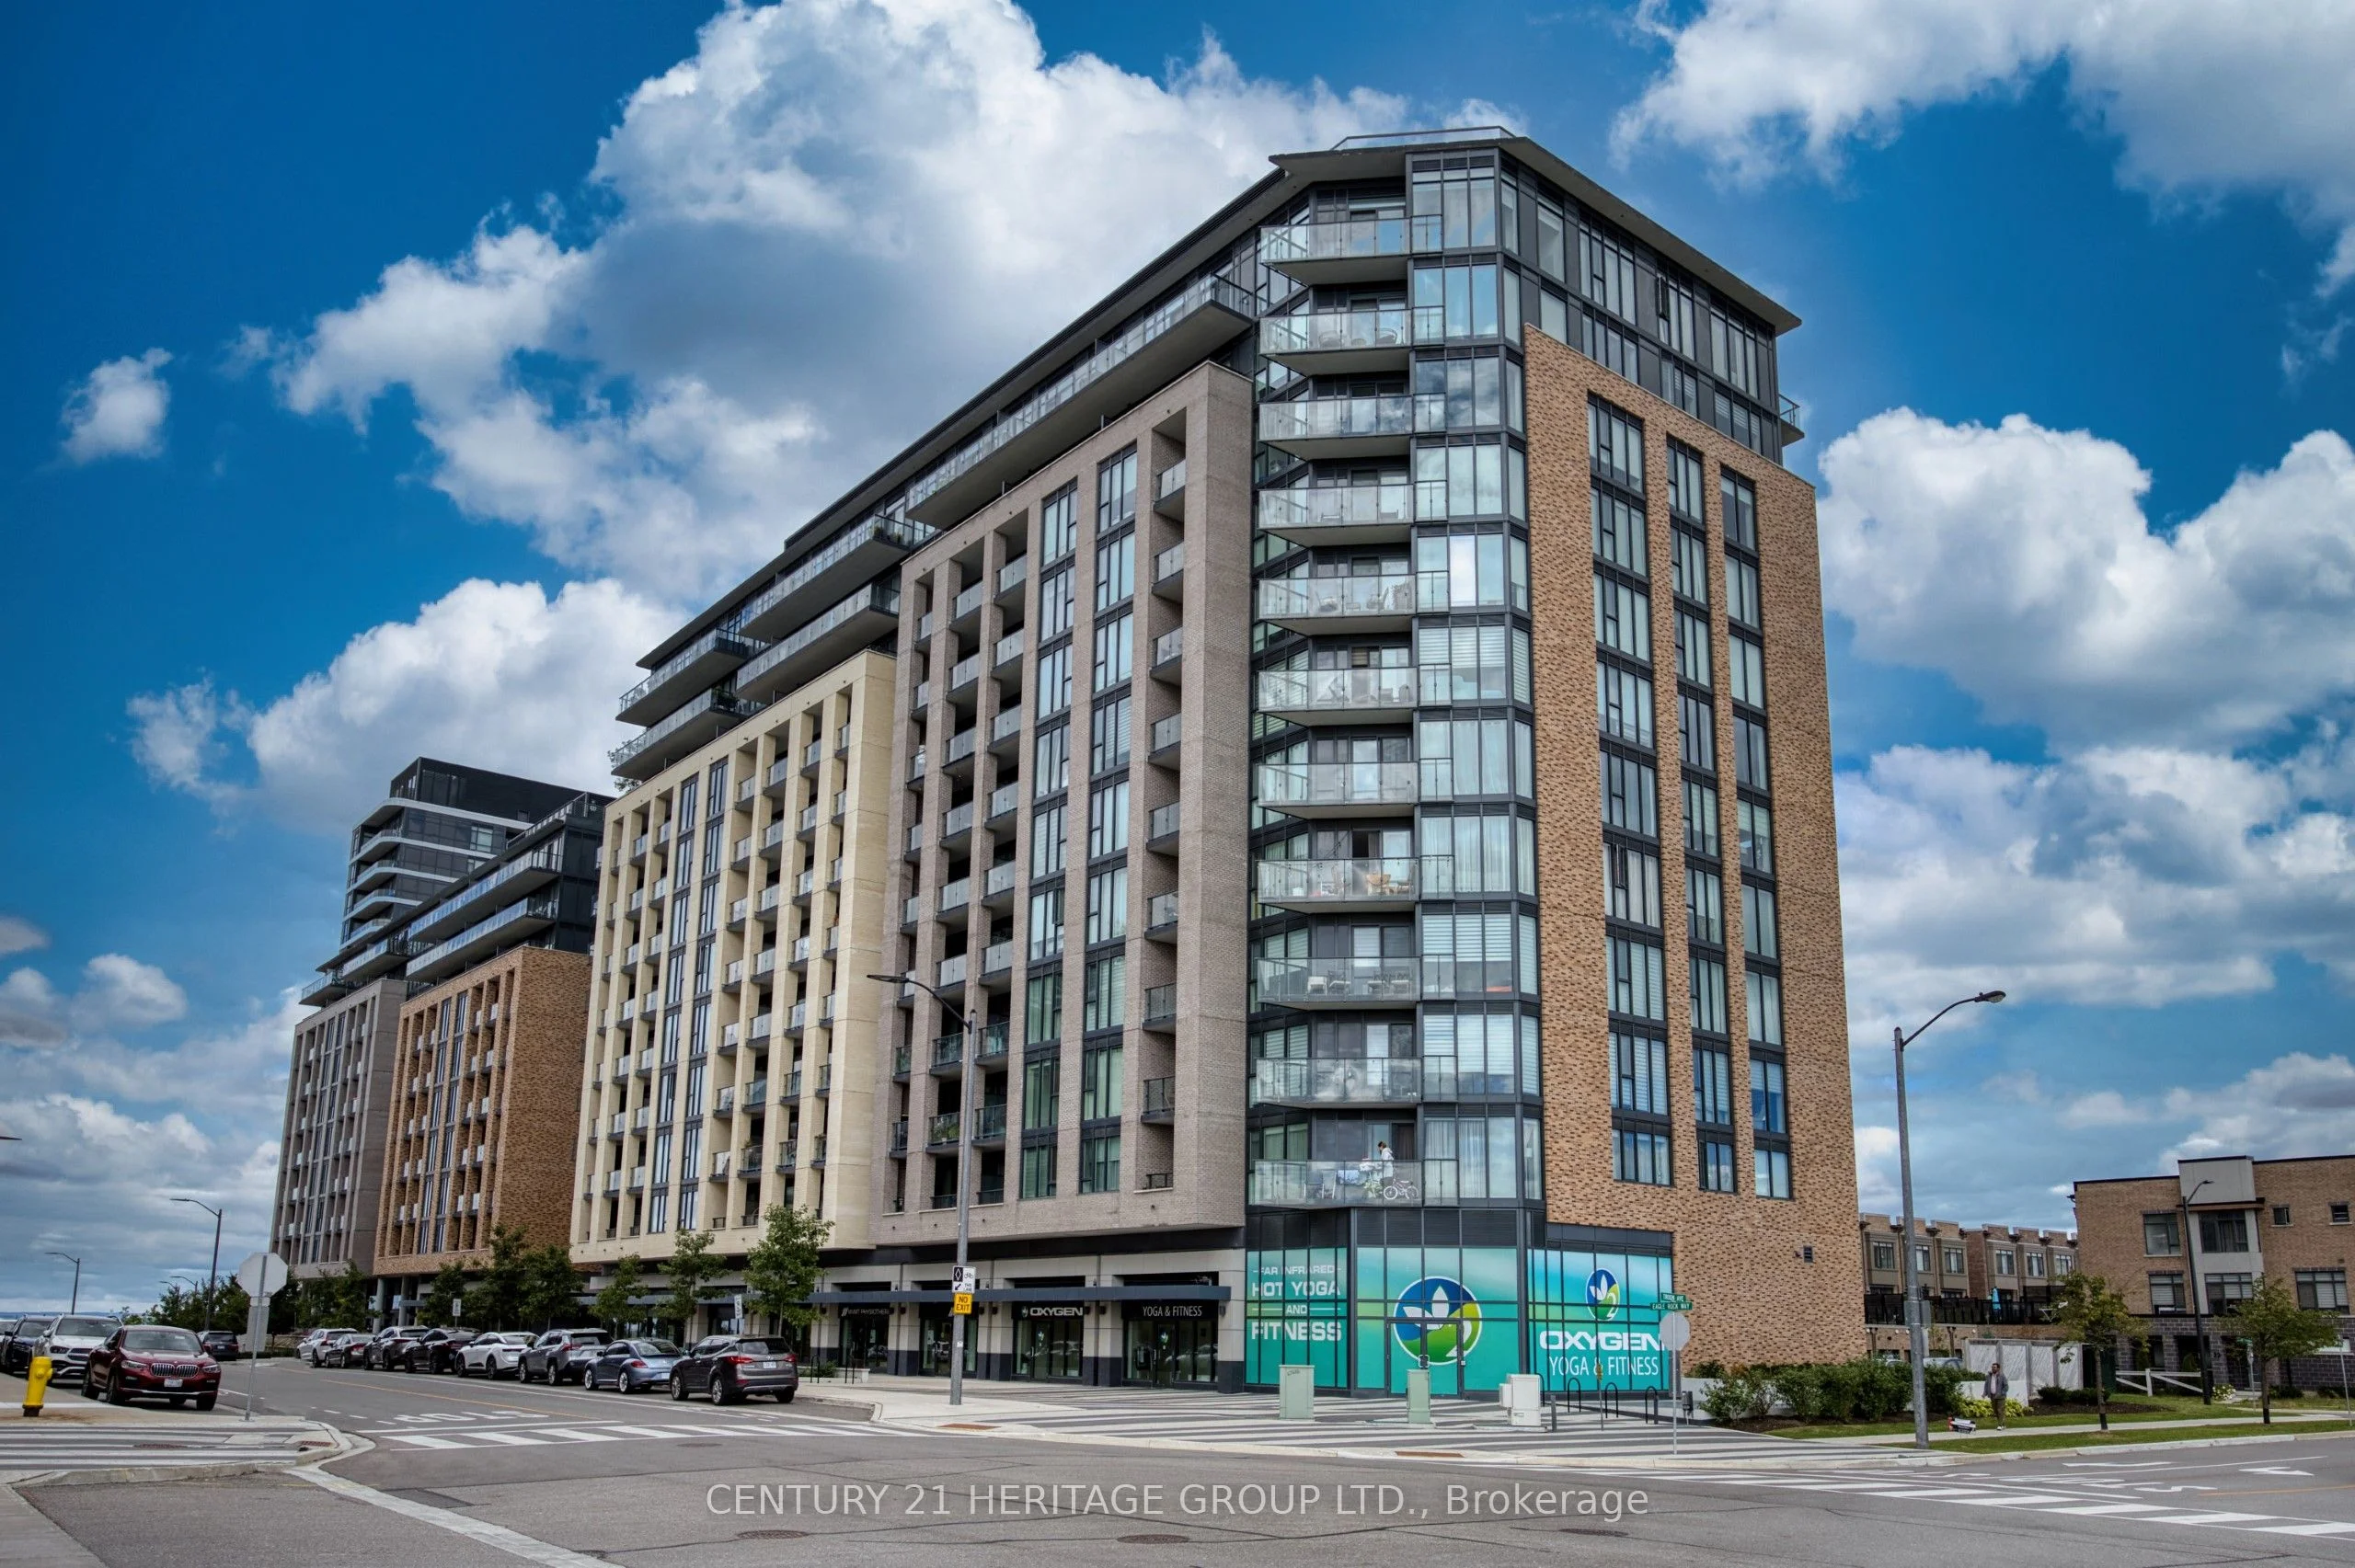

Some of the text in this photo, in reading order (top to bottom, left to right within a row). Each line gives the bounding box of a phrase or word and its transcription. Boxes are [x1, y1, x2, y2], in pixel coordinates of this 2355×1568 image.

[1252, 1281, 1340, 1297] HOT YOGA
[1030, 1307, 1083, 1316] OXYGEN
[1143, 1306, 1202, 1316] YOGA & FITNESS
[1286, 1305, 1307, 1313] AND
[1252, 1322, 1342, 1341] FITNESS
[1540, 1331, 1665, 1351] OXYGEN
[1549, 1356, 1590, 1376] YOGA
[1608, 1356, 1659, 1376] FITNESS
